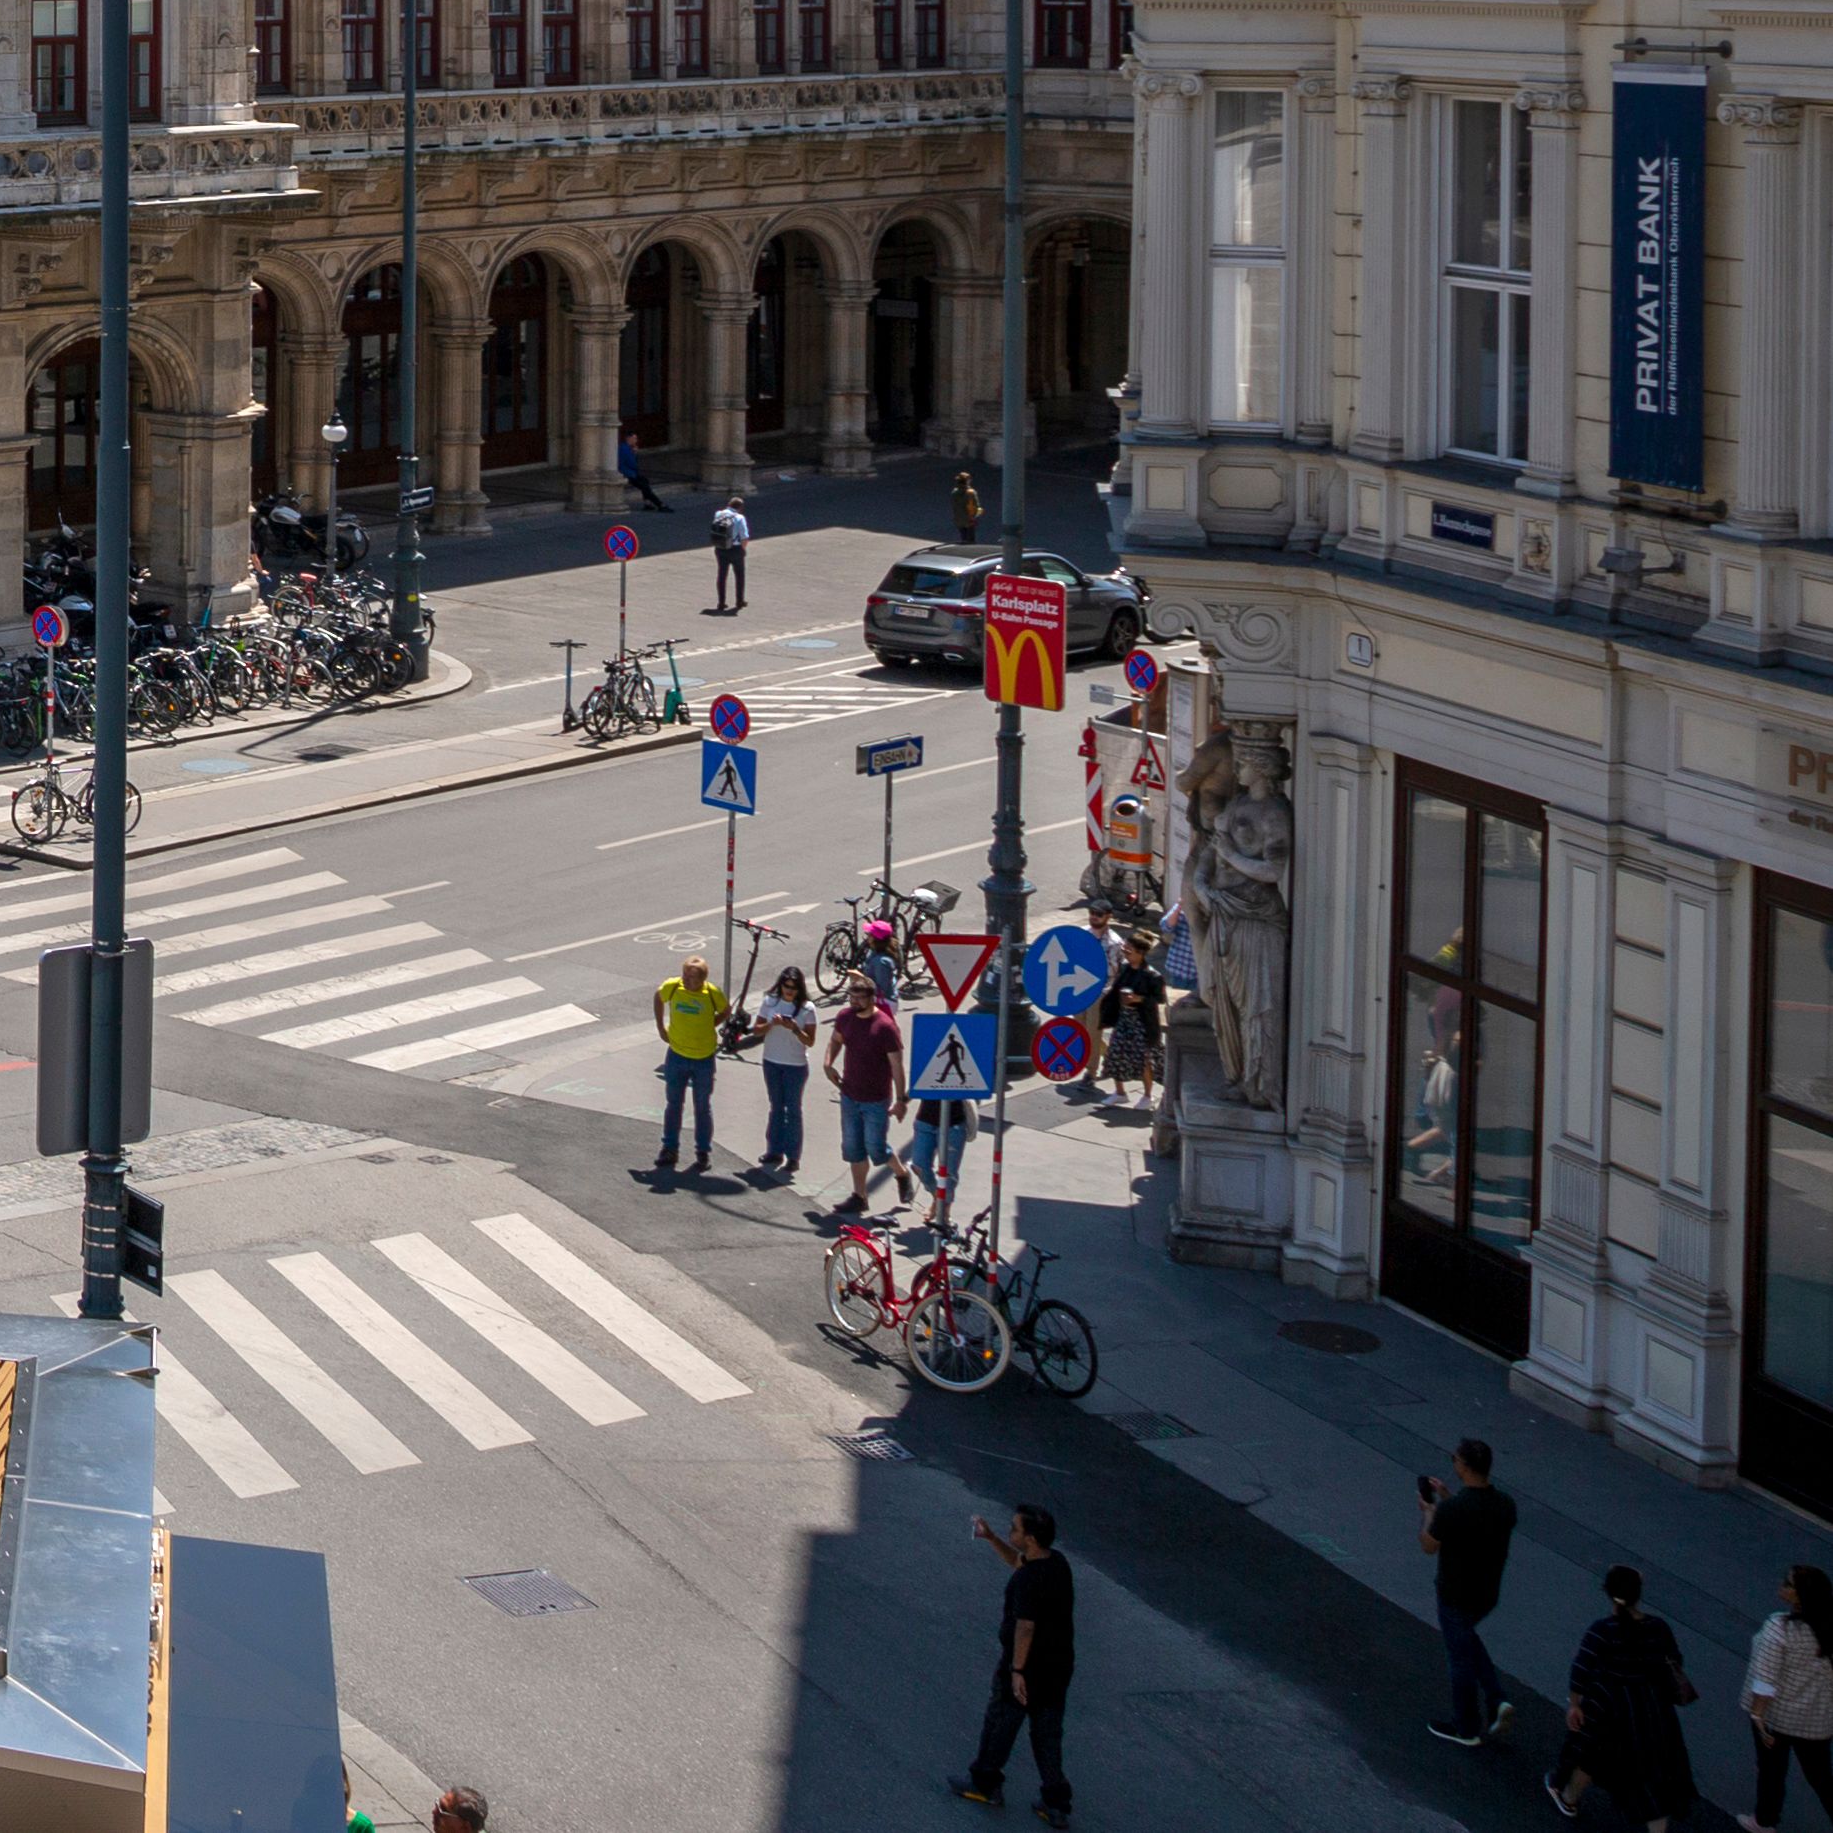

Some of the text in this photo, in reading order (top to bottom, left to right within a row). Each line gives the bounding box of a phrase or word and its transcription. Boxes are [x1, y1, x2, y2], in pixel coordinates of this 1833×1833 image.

[1636, 157, 1661, 413] PRIVAT BANK
[1668, 157, 1680, 415] der Raiffeisenlandesbank Oberösterreich
[992, 594, 1059, 615] Karlsplatz
[991, 611, 1059, 629] U-Bahn Passage
[873, 748, 907, 768] EINBAHN
